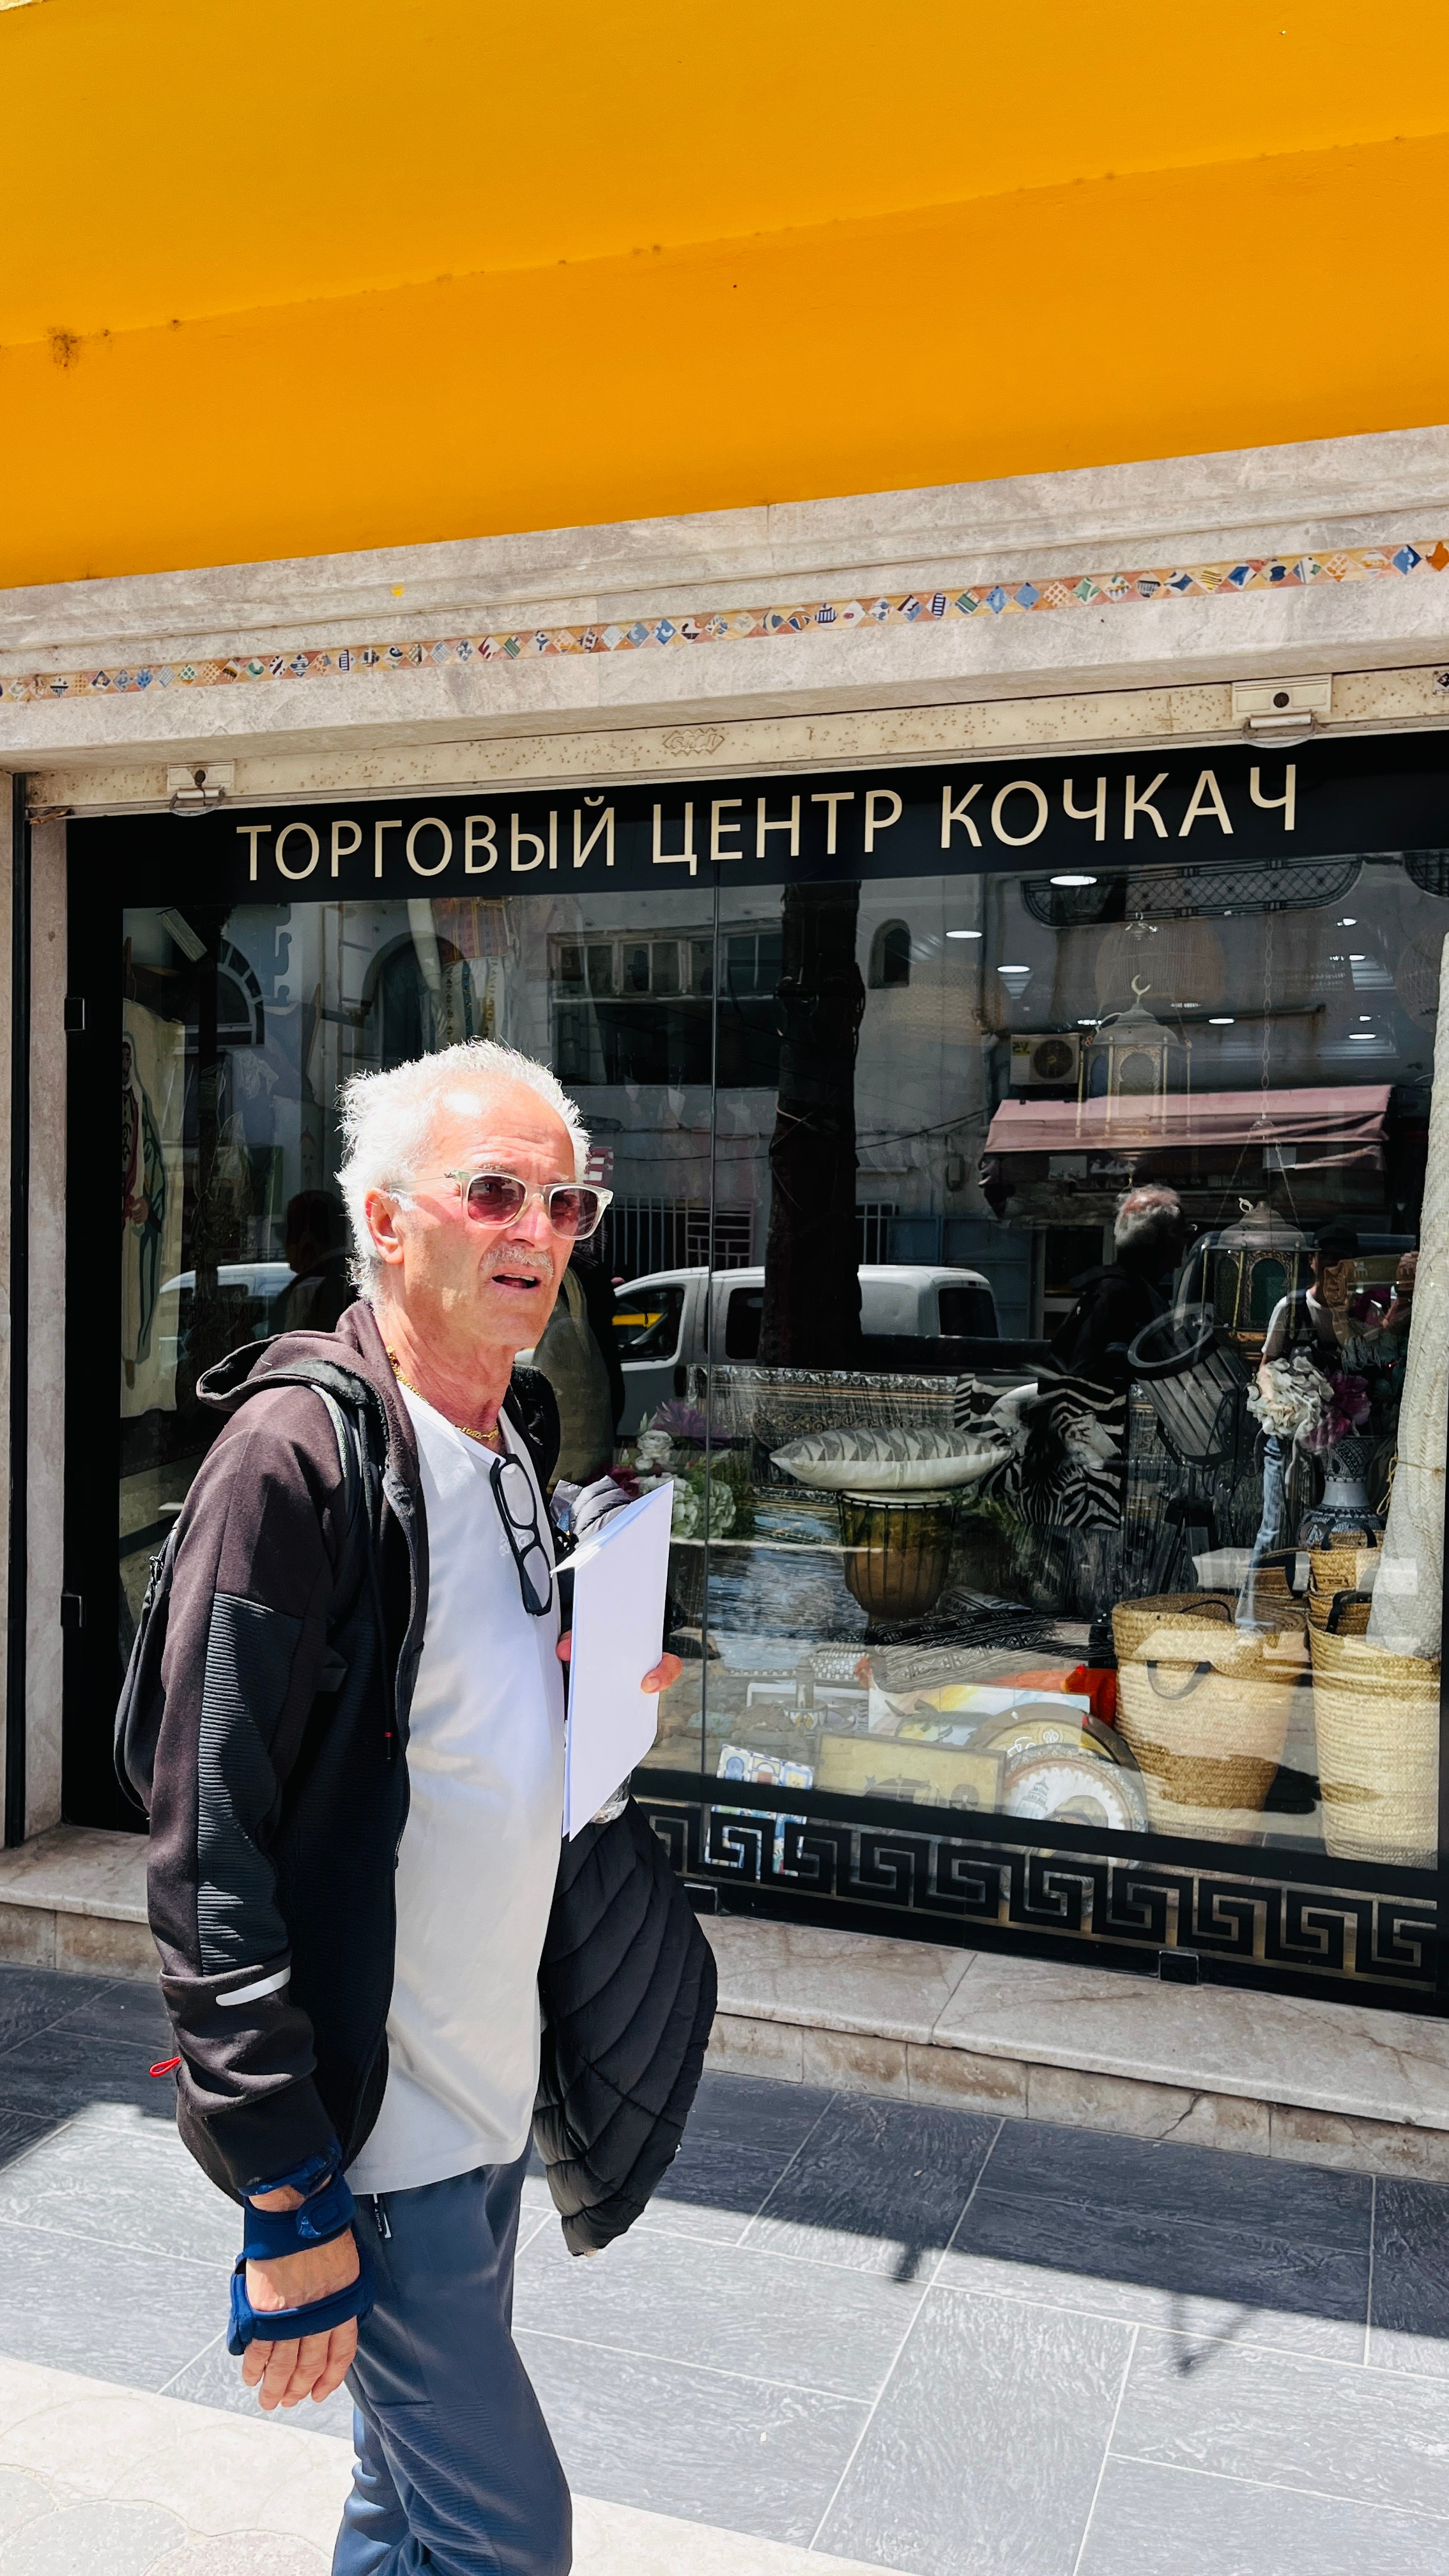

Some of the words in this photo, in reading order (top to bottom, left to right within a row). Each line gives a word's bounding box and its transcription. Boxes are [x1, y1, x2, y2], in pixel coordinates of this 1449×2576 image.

[237, 801, 615, 881] ТОРГОВЫЙ
[653, 790, 903, 866] ЦЕНТР
[941, 765, 1296, 848] КОЧКАЧ
